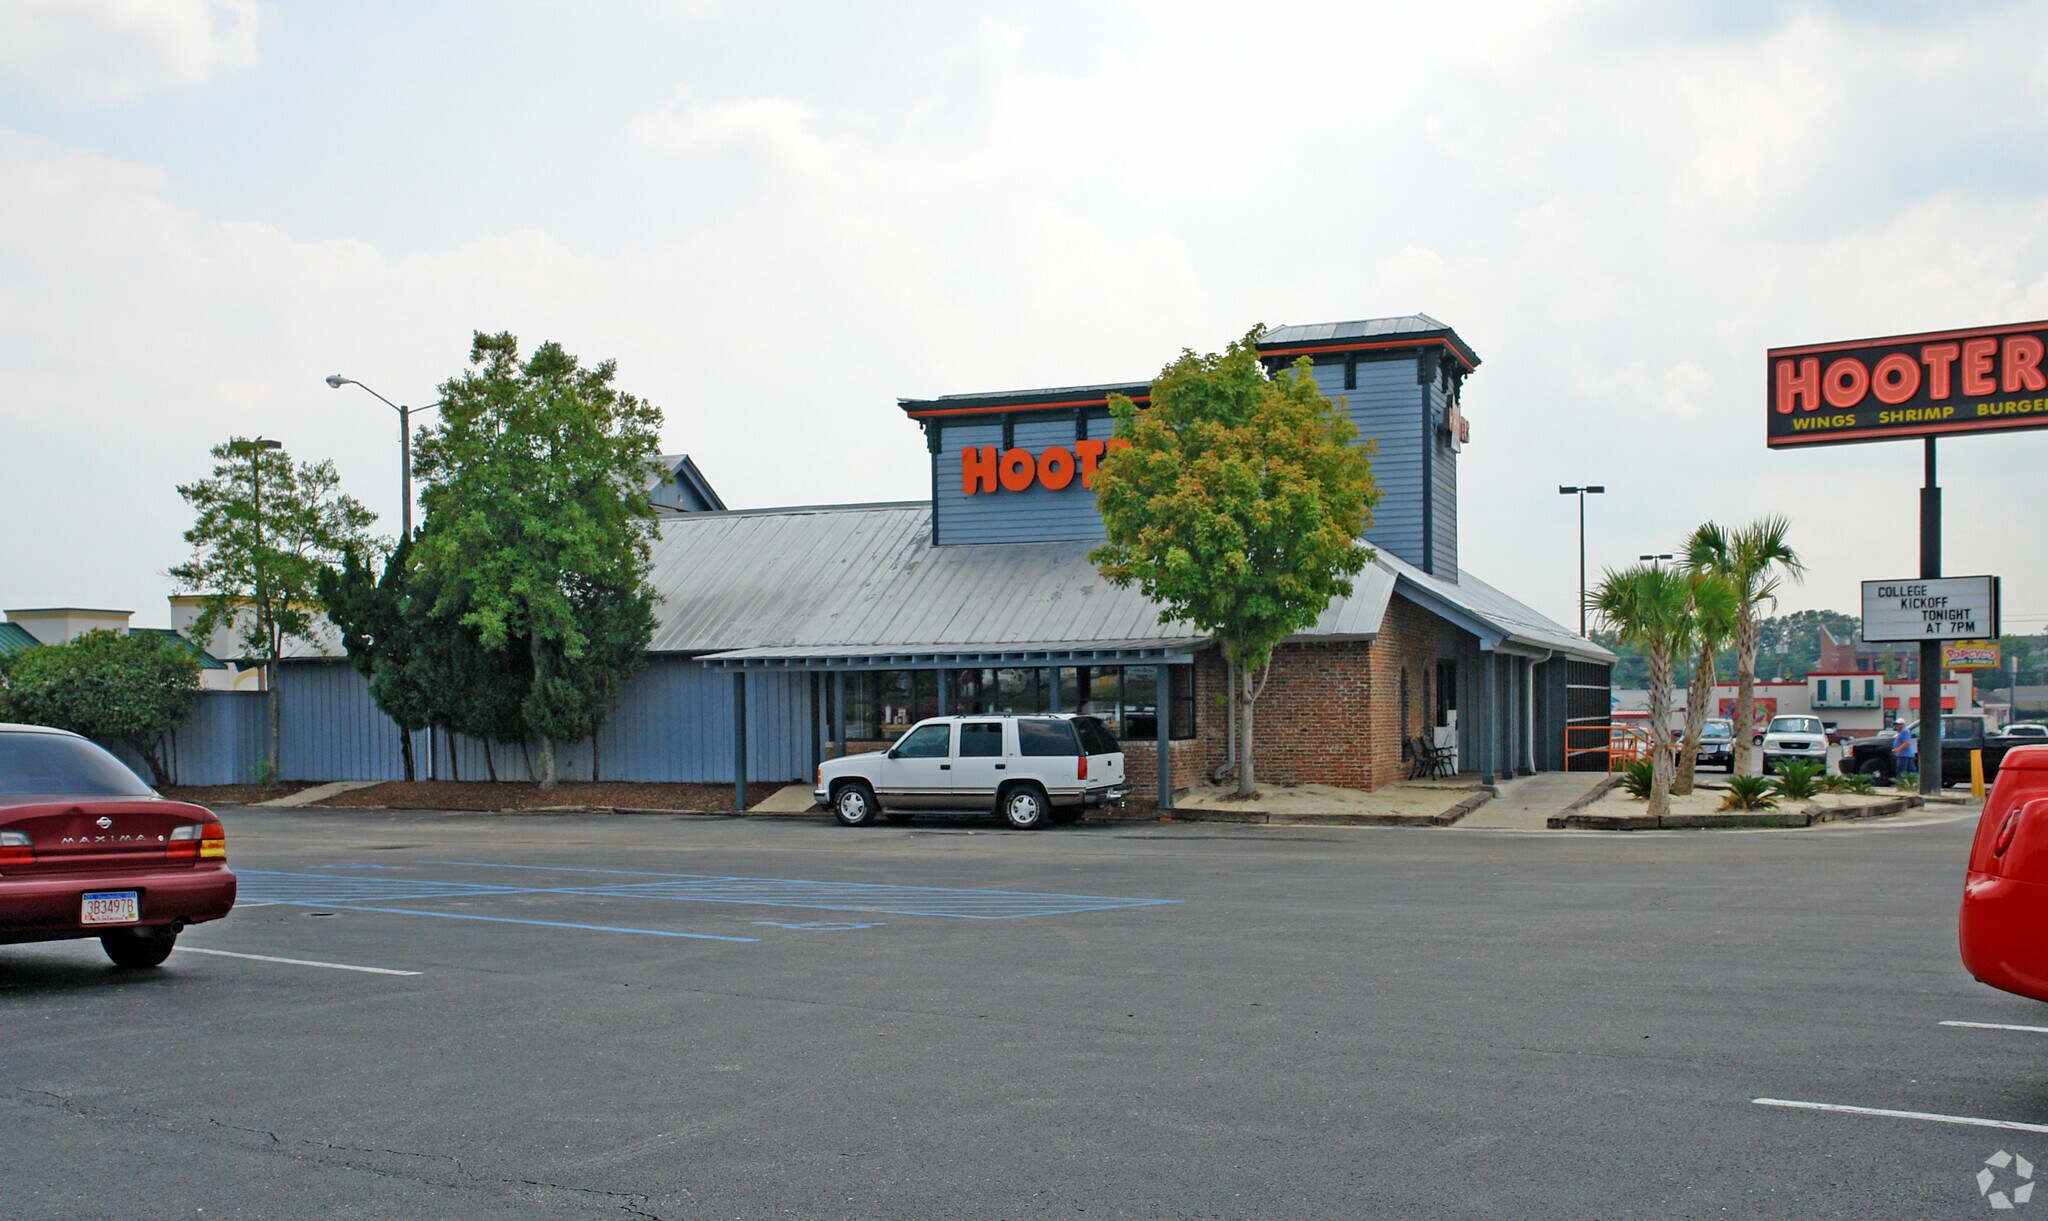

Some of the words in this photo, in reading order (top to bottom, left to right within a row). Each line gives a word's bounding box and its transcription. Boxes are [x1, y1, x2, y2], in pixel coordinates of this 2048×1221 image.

[1792, 413, 1857, 431] WINGS
[1878, 406, 1955, 424] SHRIMP
[961, 437, 1132, 495] HOOT
[1878, 585, 1928, 598] COLLEGE
[1900, 596, 1949, 610] KICKOFF
[1922, 608, 1972, 621] TONIGHT
[1925, 622, 1942, 634] AT
[1950, 621, 1975, 633] 7PM
[61, 834, 147, 844] MAXIMA
